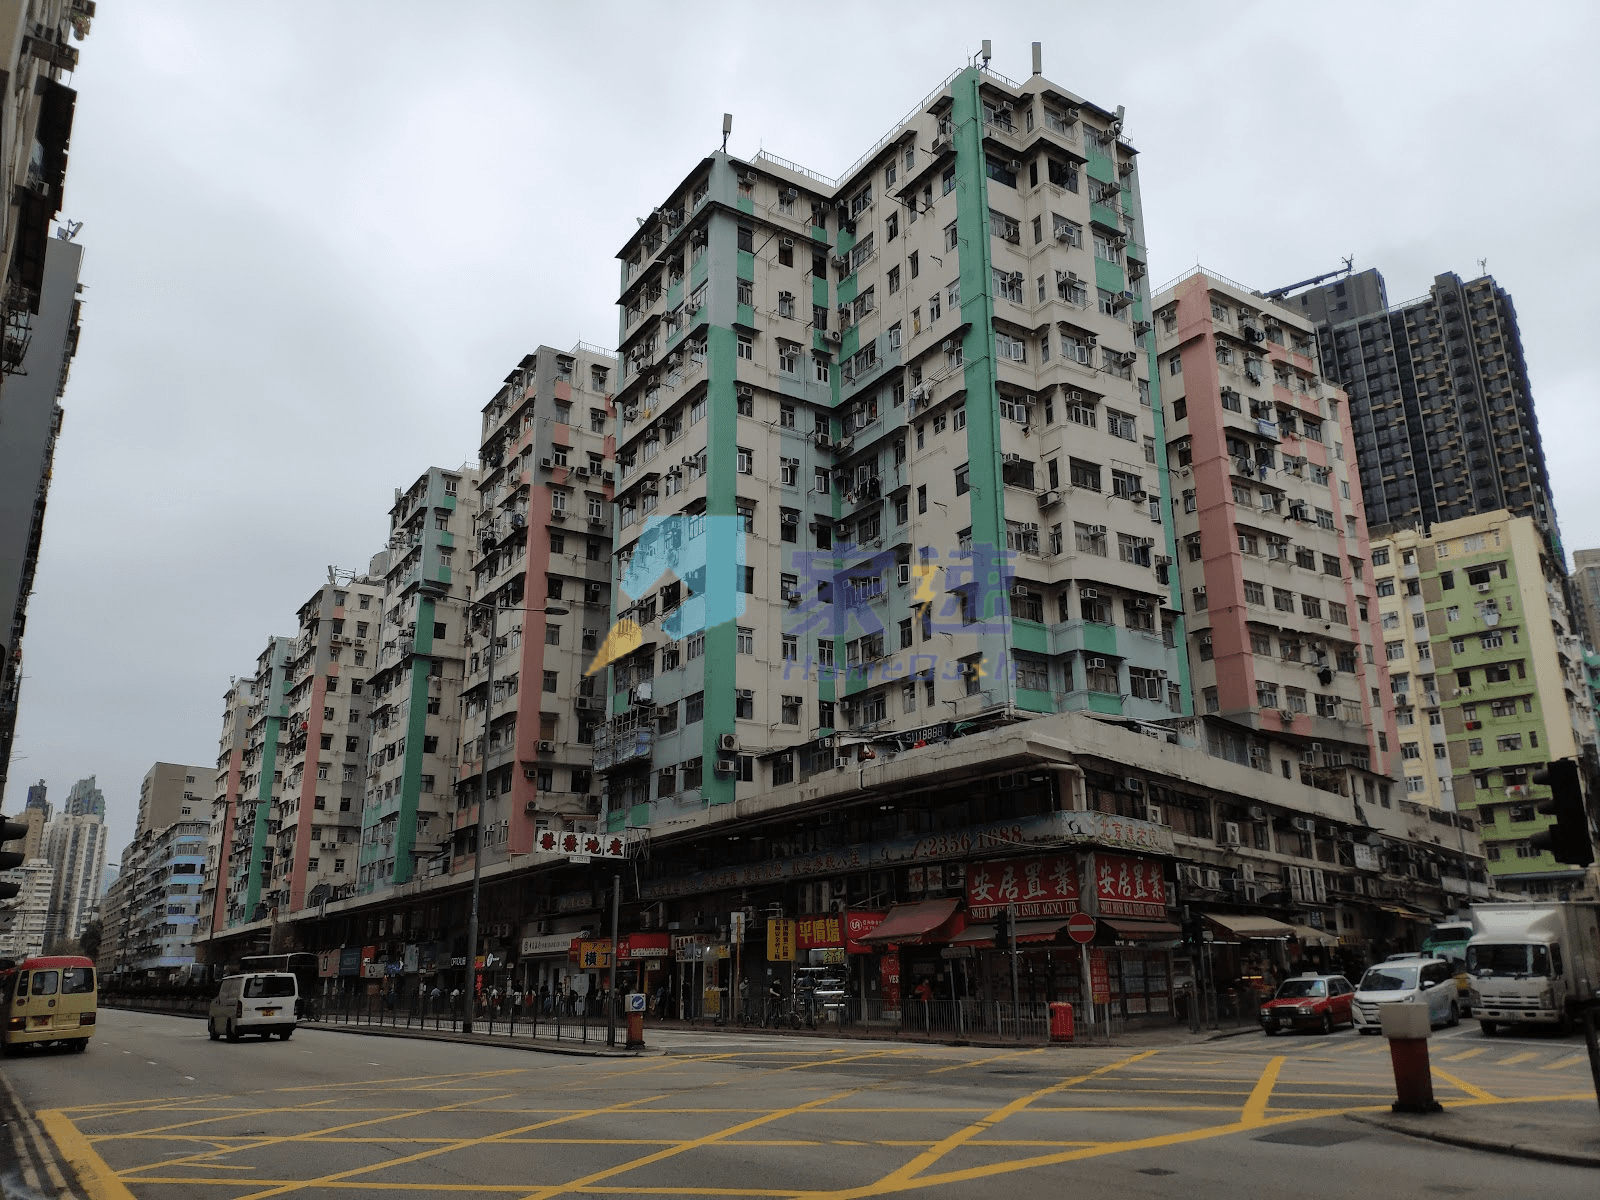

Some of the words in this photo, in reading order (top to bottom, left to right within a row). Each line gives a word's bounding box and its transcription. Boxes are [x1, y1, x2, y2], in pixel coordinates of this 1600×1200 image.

[976, 824, 1023, 849] 1688
[970, 856, 1076, 902] 安居置業
[1098, 858, 1164, 901] 安居置業
[971, 906, 988, 920] SWEET
[1021, 903, 1041, 917] ESTATE
[1041, 902, 1065, 916] AGENCY
[888, 974, 900, 984] YES
